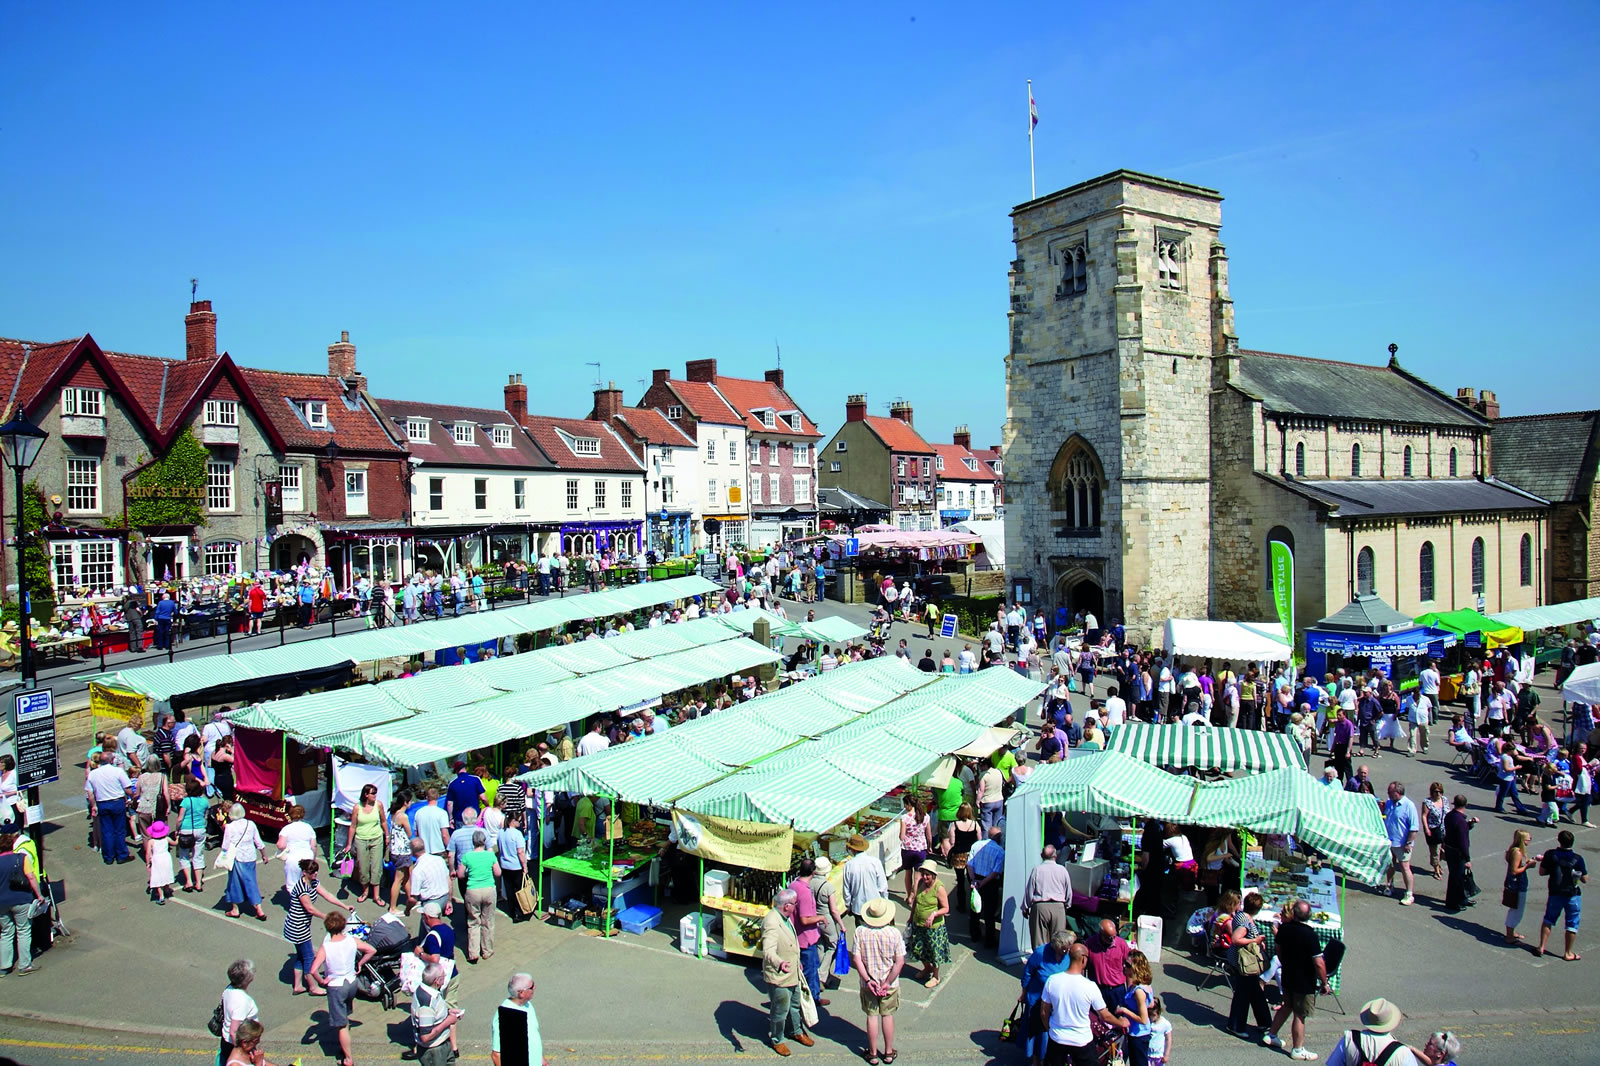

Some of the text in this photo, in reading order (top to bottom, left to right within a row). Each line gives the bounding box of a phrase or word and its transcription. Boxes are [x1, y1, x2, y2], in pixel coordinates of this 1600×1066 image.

[127, 487, 206, 498] KINGS HEAD
[20, 696, 31, 714] P
